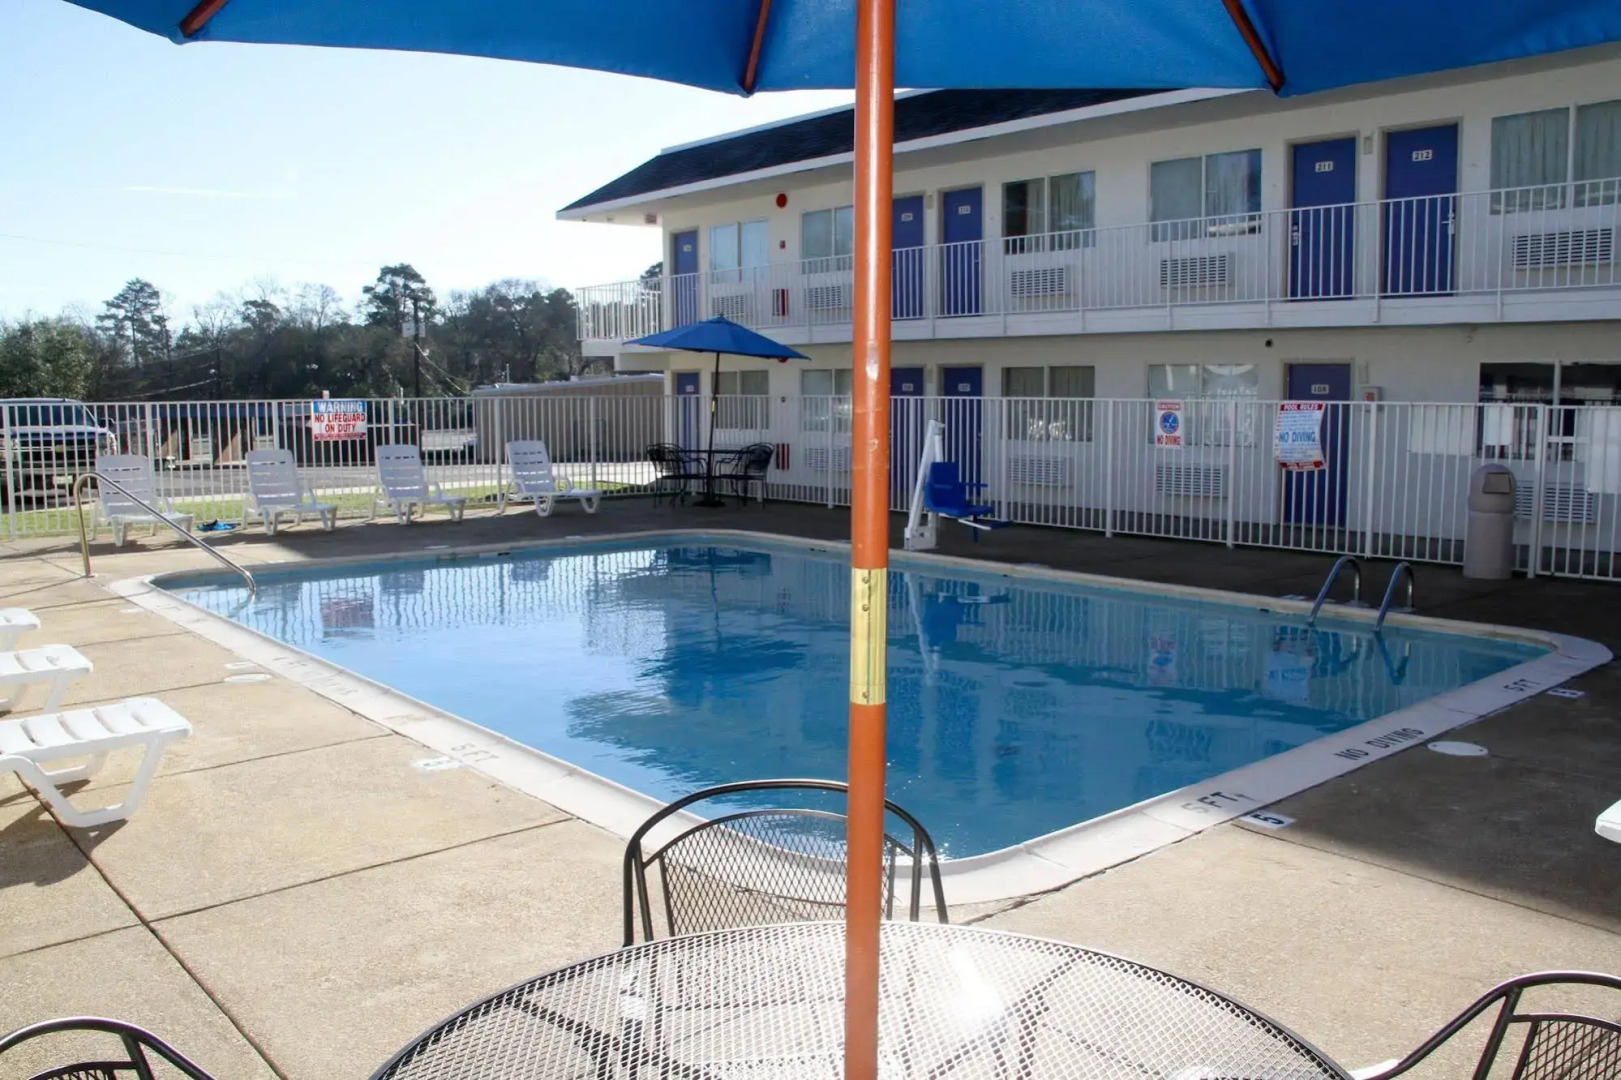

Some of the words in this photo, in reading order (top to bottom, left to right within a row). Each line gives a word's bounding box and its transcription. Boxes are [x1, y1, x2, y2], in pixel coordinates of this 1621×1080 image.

[1414, 151, 1430, 160] 212
[1317, 162, 1331, 171] 211
[317, 401, 363, 413] WARNING
[315, 414, 325, 423] NO
[328, 413, 365, 422] LIFEGUARD
[325, 424, 335, 433] ON
[338, 424, 356, 433] DUTY
[1157, 434, 1164, 445] NO
[1165, 434, 1181, 445] DIVING
[1278, 431, 1289, 443] NO
[1291, 431, 1316, 443] DIVING
[1334, 748, 1369, 761] NO
[1364, 727, 1425, 749] DIVING
